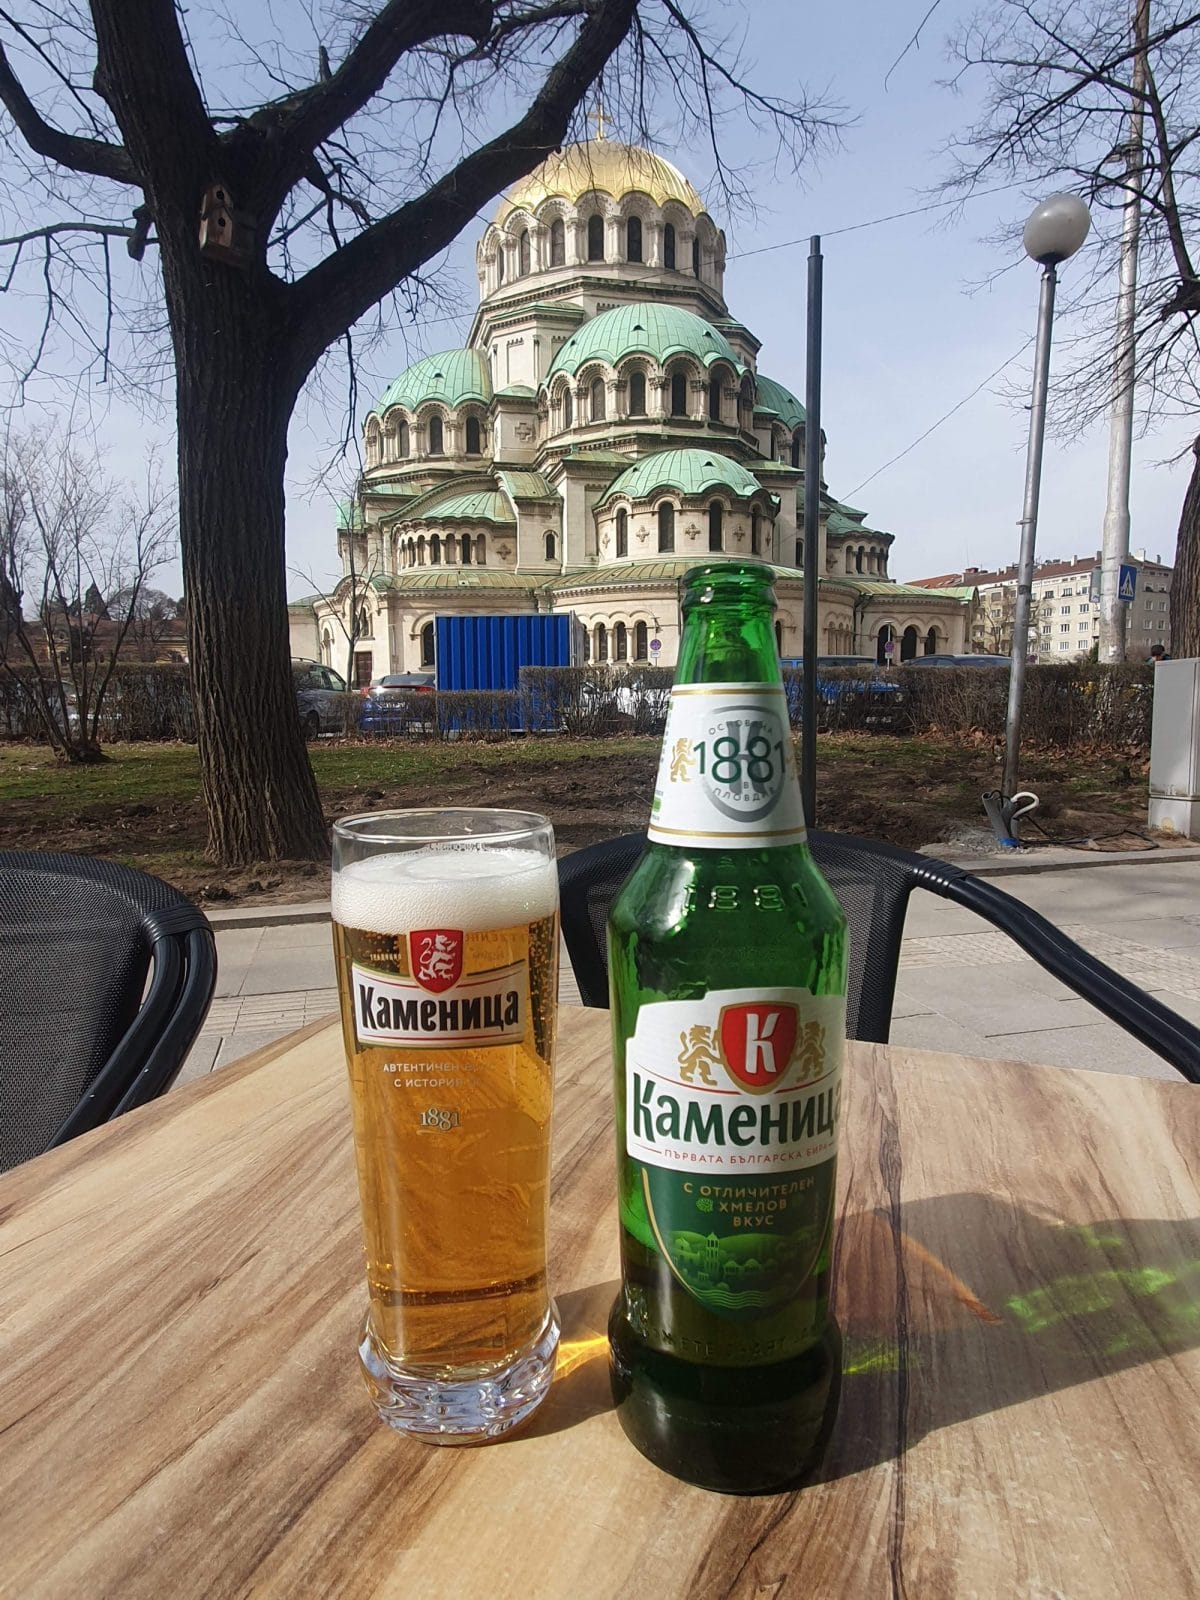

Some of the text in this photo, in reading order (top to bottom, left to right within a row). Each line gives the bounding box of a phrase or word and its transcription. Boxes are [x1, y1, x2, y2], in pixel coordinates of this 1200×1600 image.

[693, 735, 786, 784] 1881
[359, 984, 519, 1032] Каменица
[745, 1013, 781, 1074] К
[383, 1063, 459, 1073] АВТЕНТИЧЕН
[394, 1079, 402, 1088] С
[420, 1106, 459, 1131] 1881
[664, 1149, 724, 1164] ПЪРВАТА
[730, 1151, 802, 1164] БЪЛГАРСКА
[683, 1176, 815, 1198] С ОТЛИЧИТЕЛЕН
[719, 1199, 787, 1213] ХМЕЛОВ
[733, 1215, 774, 1227] ВКУС
